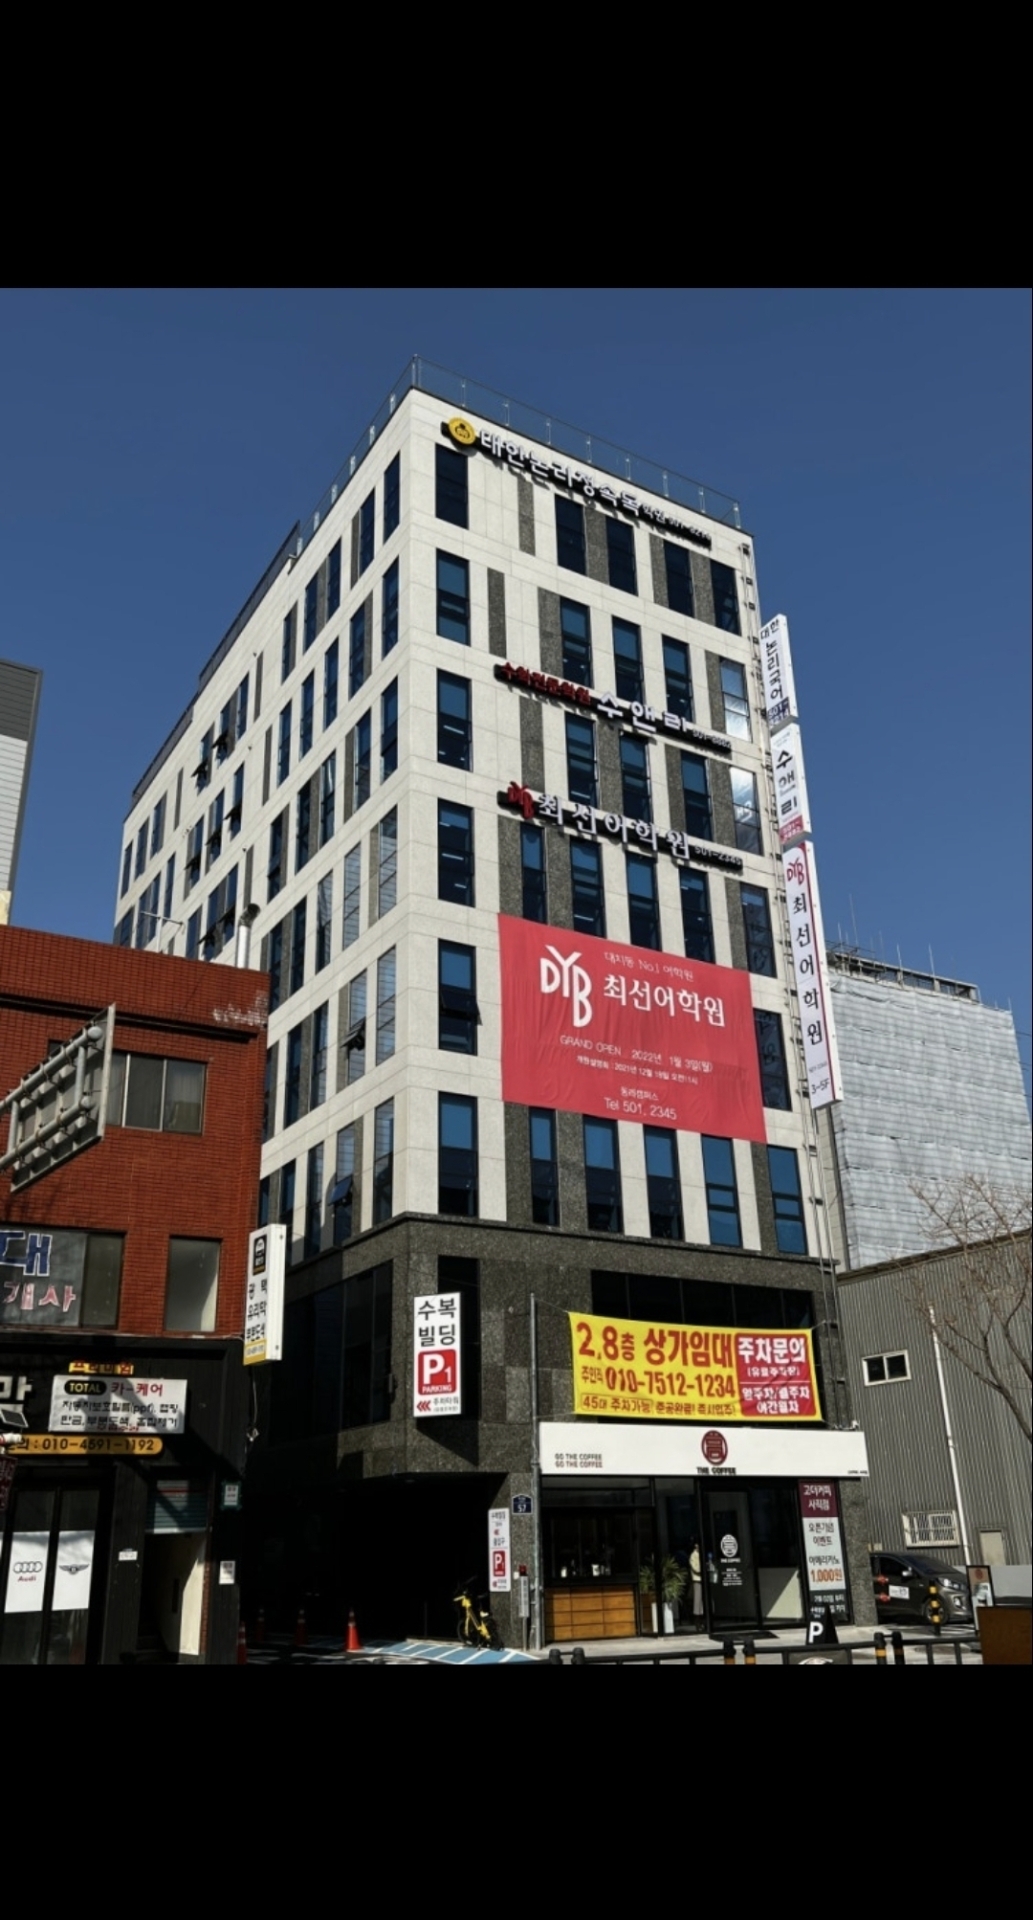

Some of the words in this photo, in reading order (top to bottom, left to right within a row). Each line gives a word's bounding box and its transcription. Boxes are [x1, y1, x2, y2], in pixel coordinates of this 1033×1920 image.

[760, 618, 779, 640] 대한
[765, 640, 784, 700] 논리국어
[500, 661, 592, 706] 수학전문학원
[597, 691, 688, 733] 수앤리
[776, 749, 798, 815] 수앤리
[538, 793, 691, 860] 최선어학원
[786, 858, 805, 885] DYB
[604, 951, 634, 969] 대치동
[663, 966, 694, 983] 어학원
[793, 893, 823, 1046] 최선어학원
[540, 945, 593, 1027] DYB
[603, 974, 726, 1028] 최선어학원
[560, 1034, 593, 1051] GRAND
[596, 1041, 621, 1056] OPEN
[632, 1049, 662, 1065] 2022년
[669, 1055, 682, 1069] 1월
[615, 1062, 637, 1075] 2021년
[639, 1068, 653, 1078] 12월
[604, 1097, 619, 1111] Tel
[650, 1105, 677, 1121] 2345
[418, 1298, 457, 1321] 수복
[418, 1324, 456, 1347] 빌딩
[643, 1327, 734, 1368] 상가임대
[738, 1336, 807, 1365] 주차문의
[69, 1382, 101, 1392] TOTAL
[422, 1385, 452, 1394] PARKING
[605, 1366, 736, 1399] 010-7512-1234
[583, 1395, 608, 1411] 45대
[711, 1467, 736, 1475] COFFEE
[517, 1504, 527, 1513] 57
[808, 1499, 830, 1511] 사직점
[808, 1522, 835, 1533] 오픈기념
[813, 1535, 833, 1547] 이벤트
[808, 1555, 840, 1566] 아메리카노
[809, 1622, 824, 1643] P
